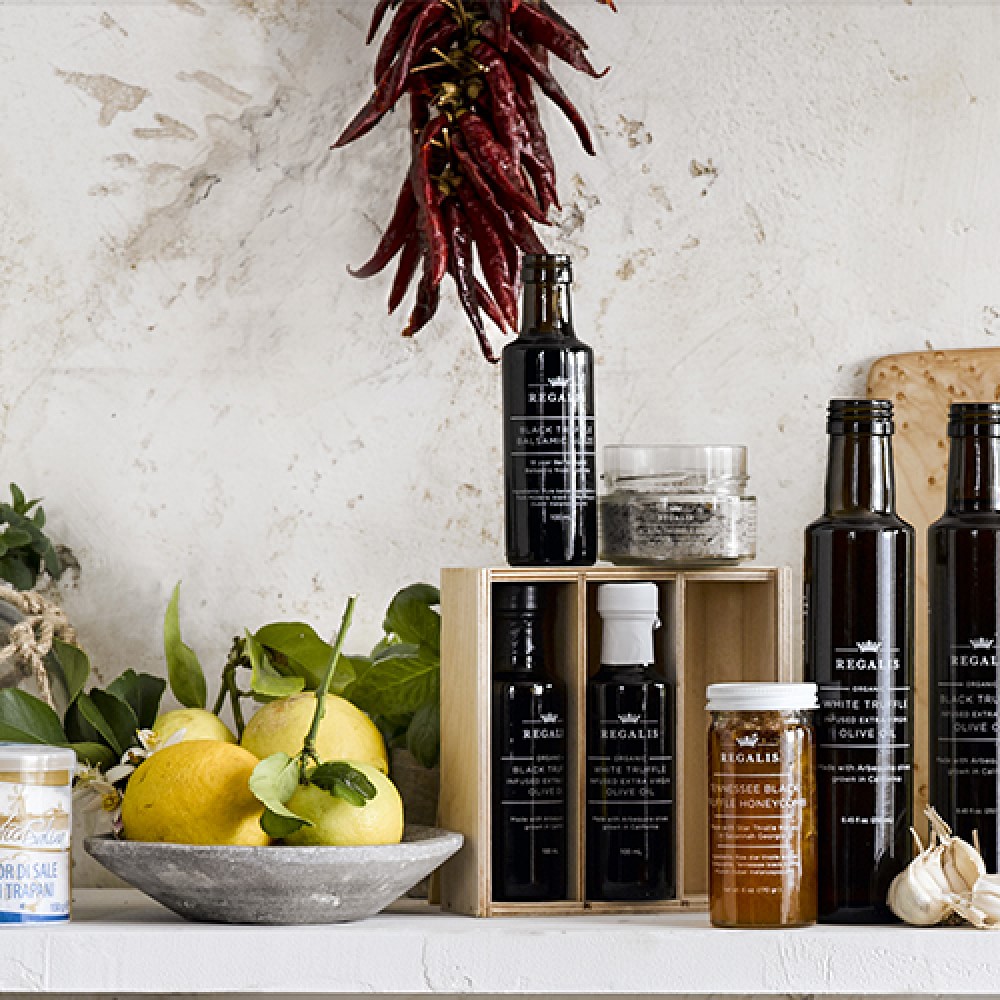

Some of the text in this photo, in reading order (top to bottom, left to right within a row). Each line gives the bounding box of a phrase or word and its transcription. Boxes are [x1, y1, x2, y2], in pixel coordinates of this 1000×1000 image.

[528, 392, 587, 403] REGA
[951, 721, 988, 733] OLIVE
[600, 728, 660, 739] REGALIS
[838, 728, 876, 740] OLIVE
[605, 787, 655, 798] OLIVE OIL
[17, 863, 31, 880] DI
[33, 861, 58, 879] SALE
